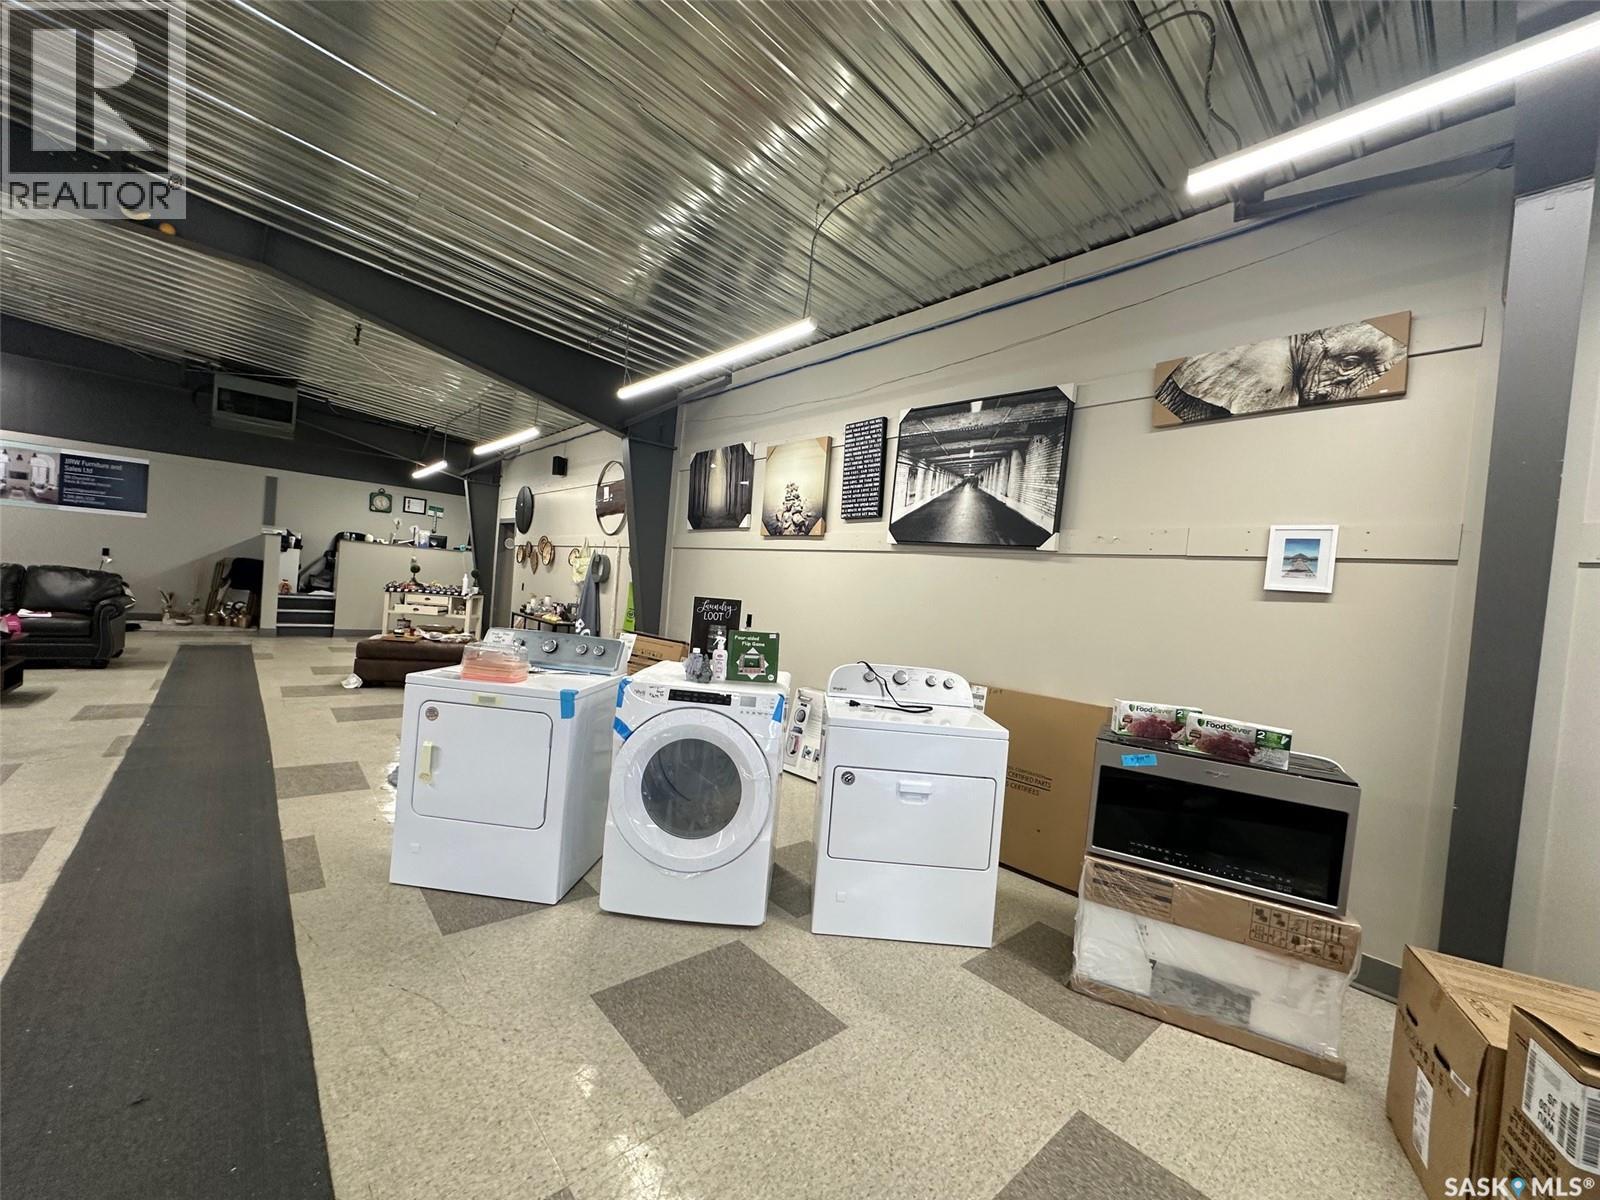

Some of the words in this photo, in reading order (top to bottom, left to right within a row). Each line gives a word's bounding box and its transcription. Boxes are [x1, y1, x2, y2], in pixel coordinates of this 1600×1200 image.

[696, 600, 737, 619] Laundry
[703, 612, 724, 621] LOOT
[1136, 705, 1173, 715] FoodSaver
[1206, 720, 1252, 735] FoodSaver
[1257, 731, 1266, 739] 2
[1008, 770, 1033, 783] CERTIFIED
[1034, 778, 1051, 788] PARTS
